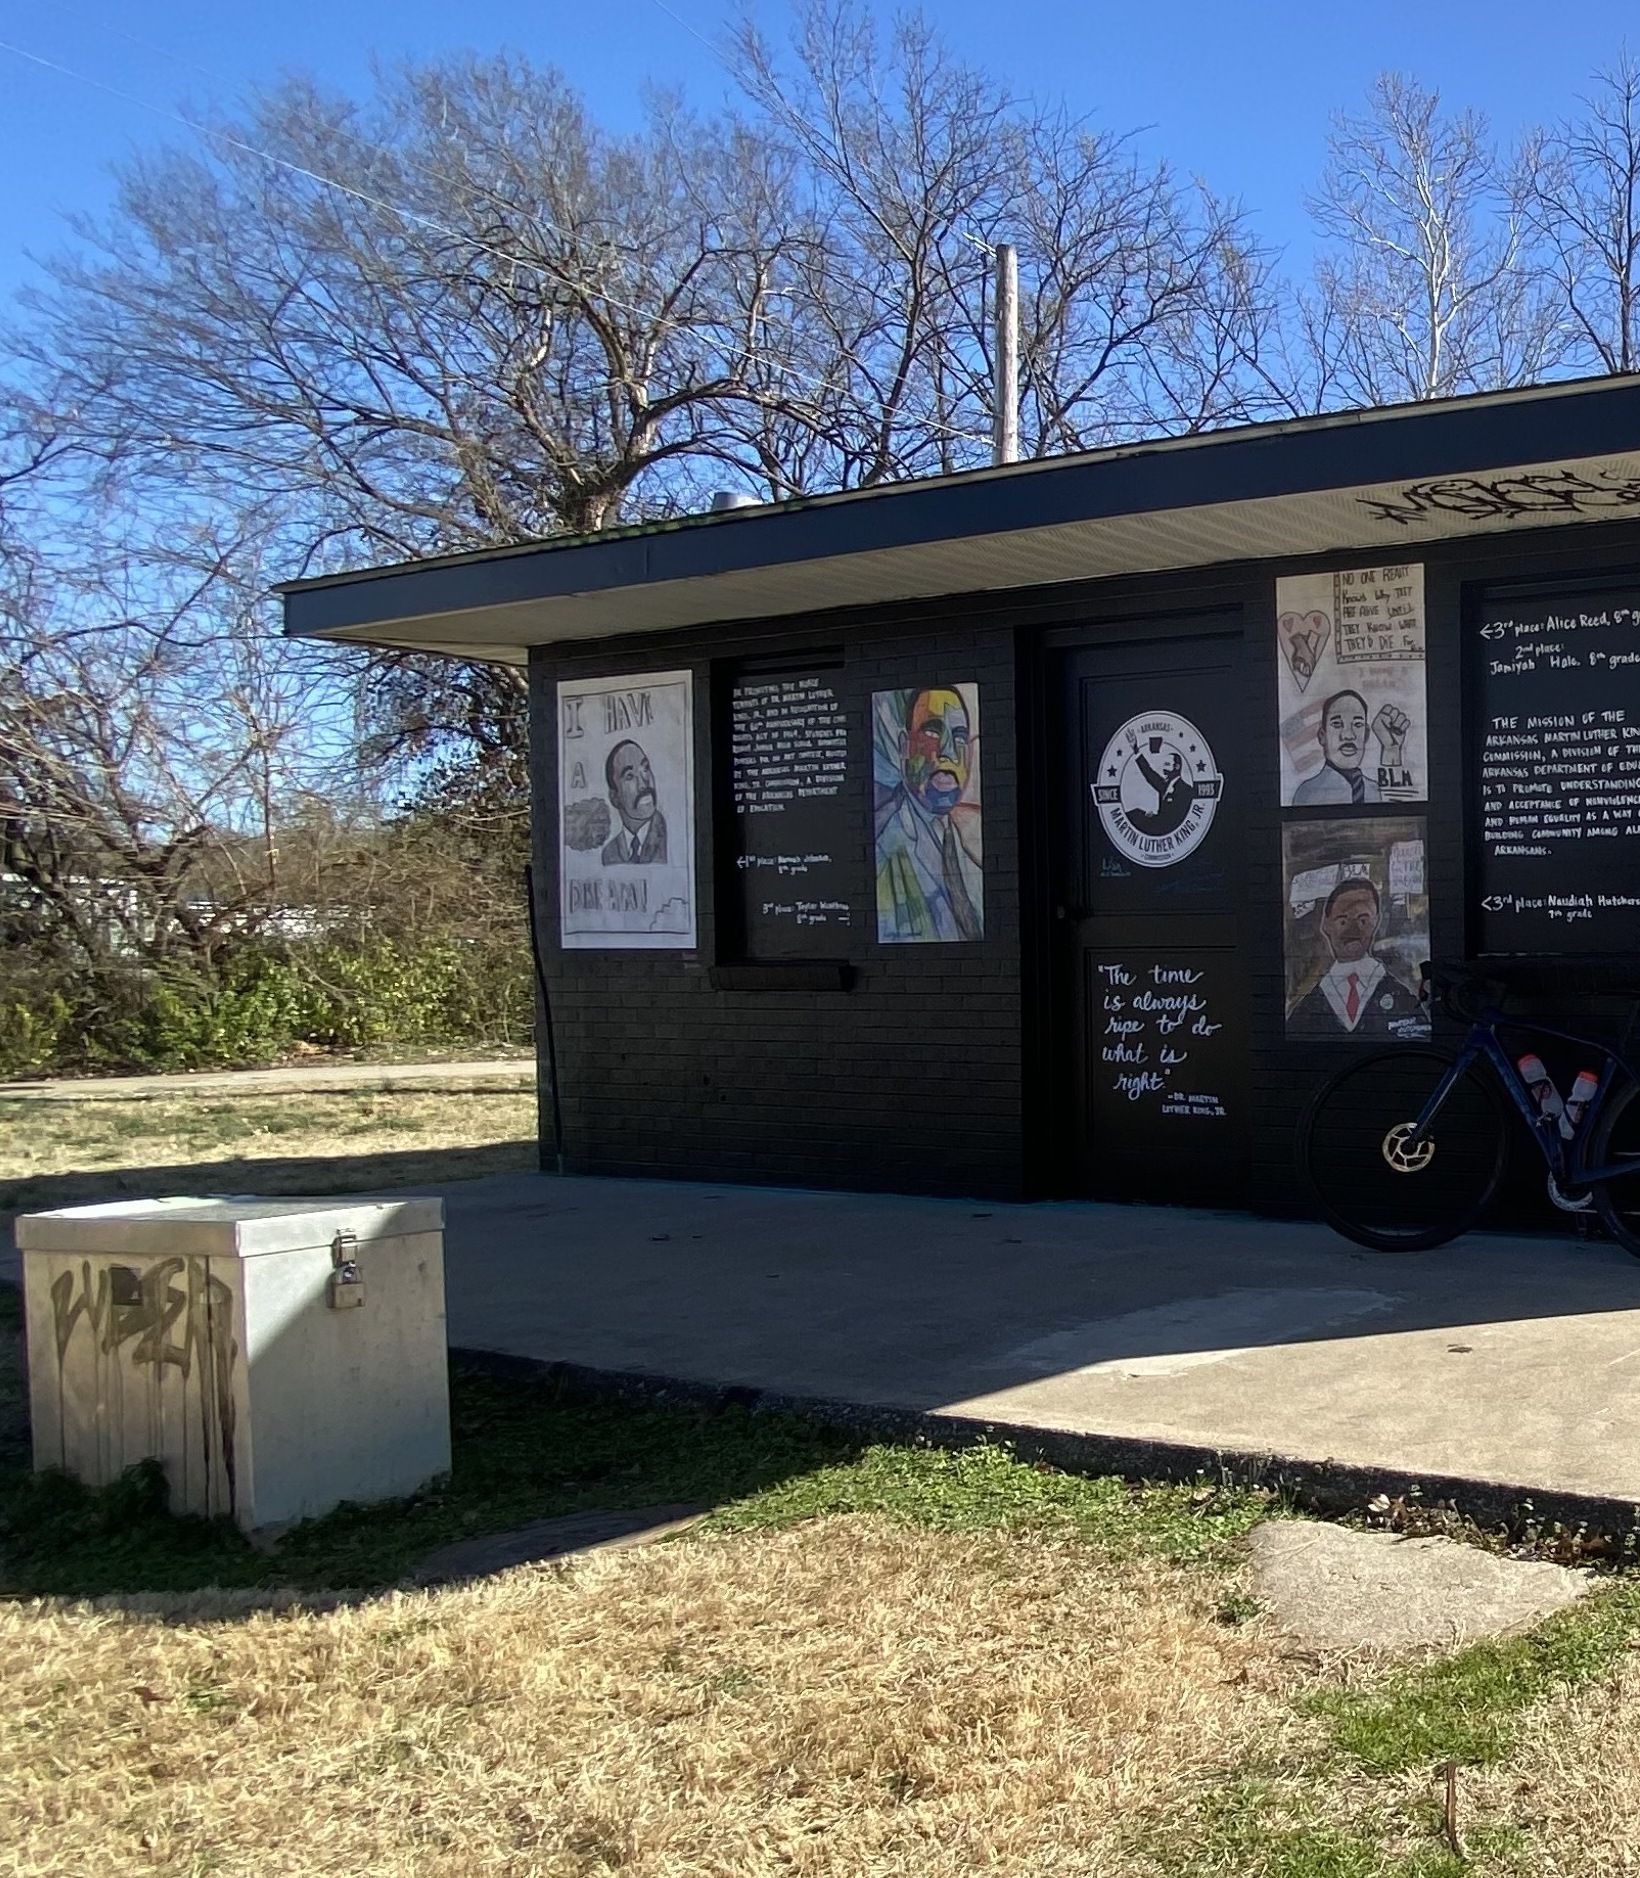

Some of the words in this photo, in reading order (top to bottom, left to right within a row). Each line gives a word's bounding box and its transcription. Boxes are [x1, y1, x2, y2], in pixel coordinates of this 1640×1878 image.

[1546, 615, 1577, 632] Alice
[566, 697, 585, 739] I
[1492, 717, 1519, 730] THE
[1527, 715, 1575, 729] MISSION
[1582, 712, 1596, 723] OF
[1600, 710, 1626, 722] THE
[1486, 734, 1539, 746] ARKANSAS
[1544, 731, 1581, 743] MARTIN
[1583, 728, 1617, 741] LUTHER
[1551, 749, 1558, 758] A
[1562, 746, 1601, 757] DIVISION
[1607, 746, 1620, 757] OF
[570, 761, 586, 789] A
[1377, 768, 1413, 787] BLM
[1482, 767, 1529, 778] ARKANSAS
[1533, 763, 1598, 775] DEPARTMENT
[1601, 762, 1614, 773] OF
[1483, 785, 1492, 796] IS
[1484, 801, 1502, 812] AND
[1508, 800, 1562, 810] ACCEPTANCE
[1568, 797, 1580, 806] OF
[1484, 816, 1503, 828] AND
[1585, 812, 1597, 821] AS
[1602, 811, 1609, 820] A
[1613, 809, 1632, 818] WAY
[1109, 807, 1138, 846] MARTIN
[1138, 836, 1174, 853] LUTHER
[1147, 964, 1204, 984] time
[1103, 988, 1125, 1011] is
[1132, 990, 1207, 1024] always
[1104, 1015, 1145, 1041] ripe
[1155, 1014, 1183, 1035] to
[1192, 1015, 1223, 1036] do
[1102, 1042, 1149, 1064] what
[1159, 1044, 1187, 1063] is
